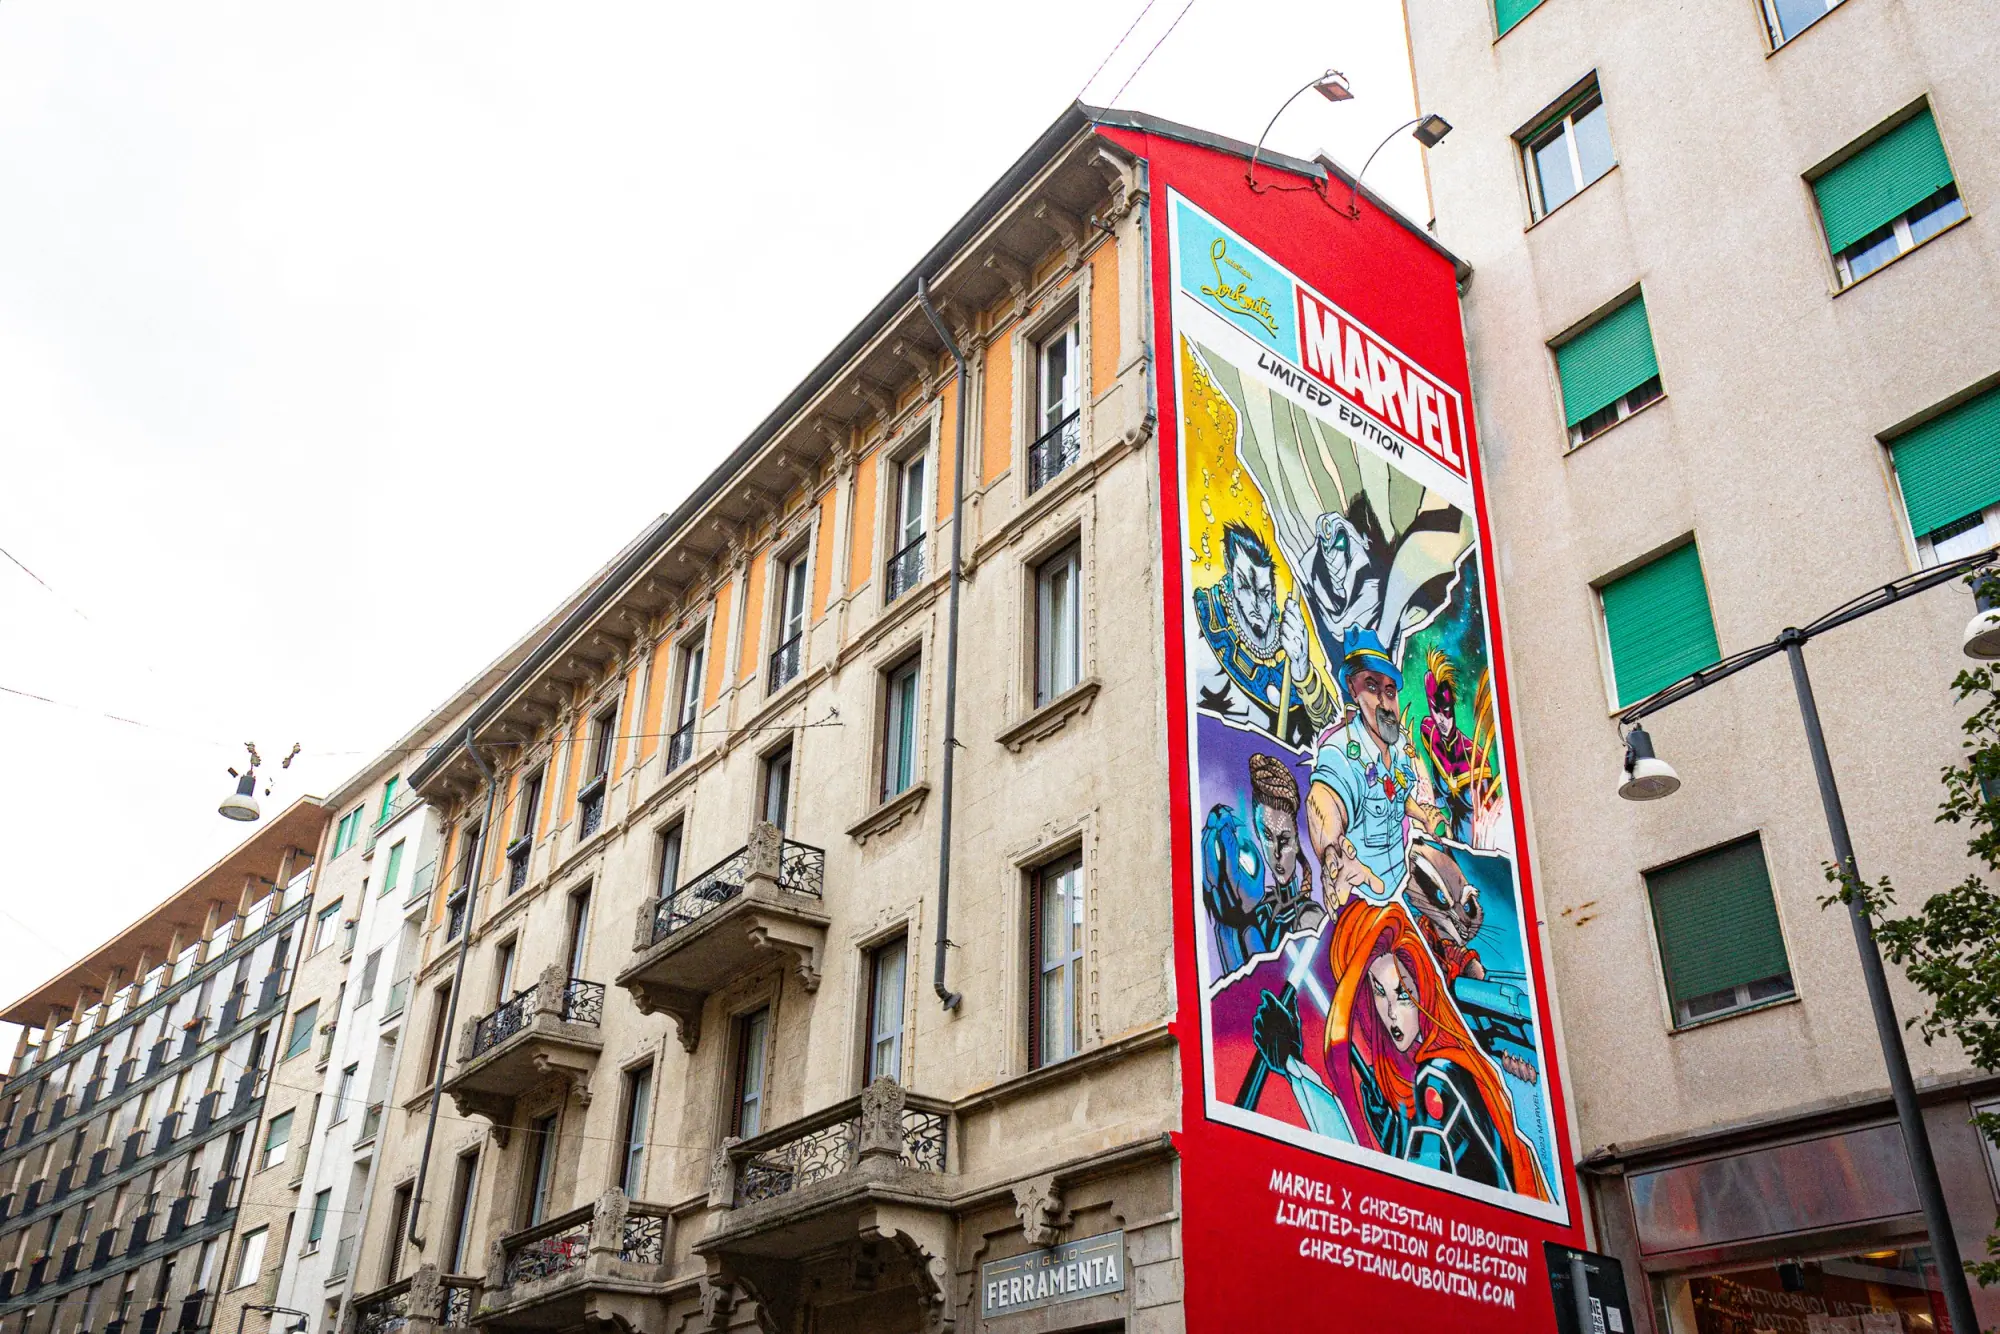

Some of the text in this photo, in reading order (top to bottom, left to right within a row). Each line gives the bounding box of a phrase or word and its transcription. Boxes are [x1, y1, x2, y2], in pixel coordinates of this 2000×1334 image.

[1257, 353, 1404, 459] LIMITED EDITION
[1301, 293, 1460, 463] MARVEL
[1533, 1092, 1544, 1134] MARVEL
[1269, 1169, 1529, 1258] MARVEL X CHRISTIAN LOUBOUTIN
[1275, 1200, 1527, 1285] LIMITED-EDITION COLLECTION
[986, 1255, 1119, 1310] FERRAMENTA
[1024, 1249, 1078, 1271] MIGLIO
[1299, 1237, 1515, 1309] CHRISTIANLOUBOUTIN.COM
